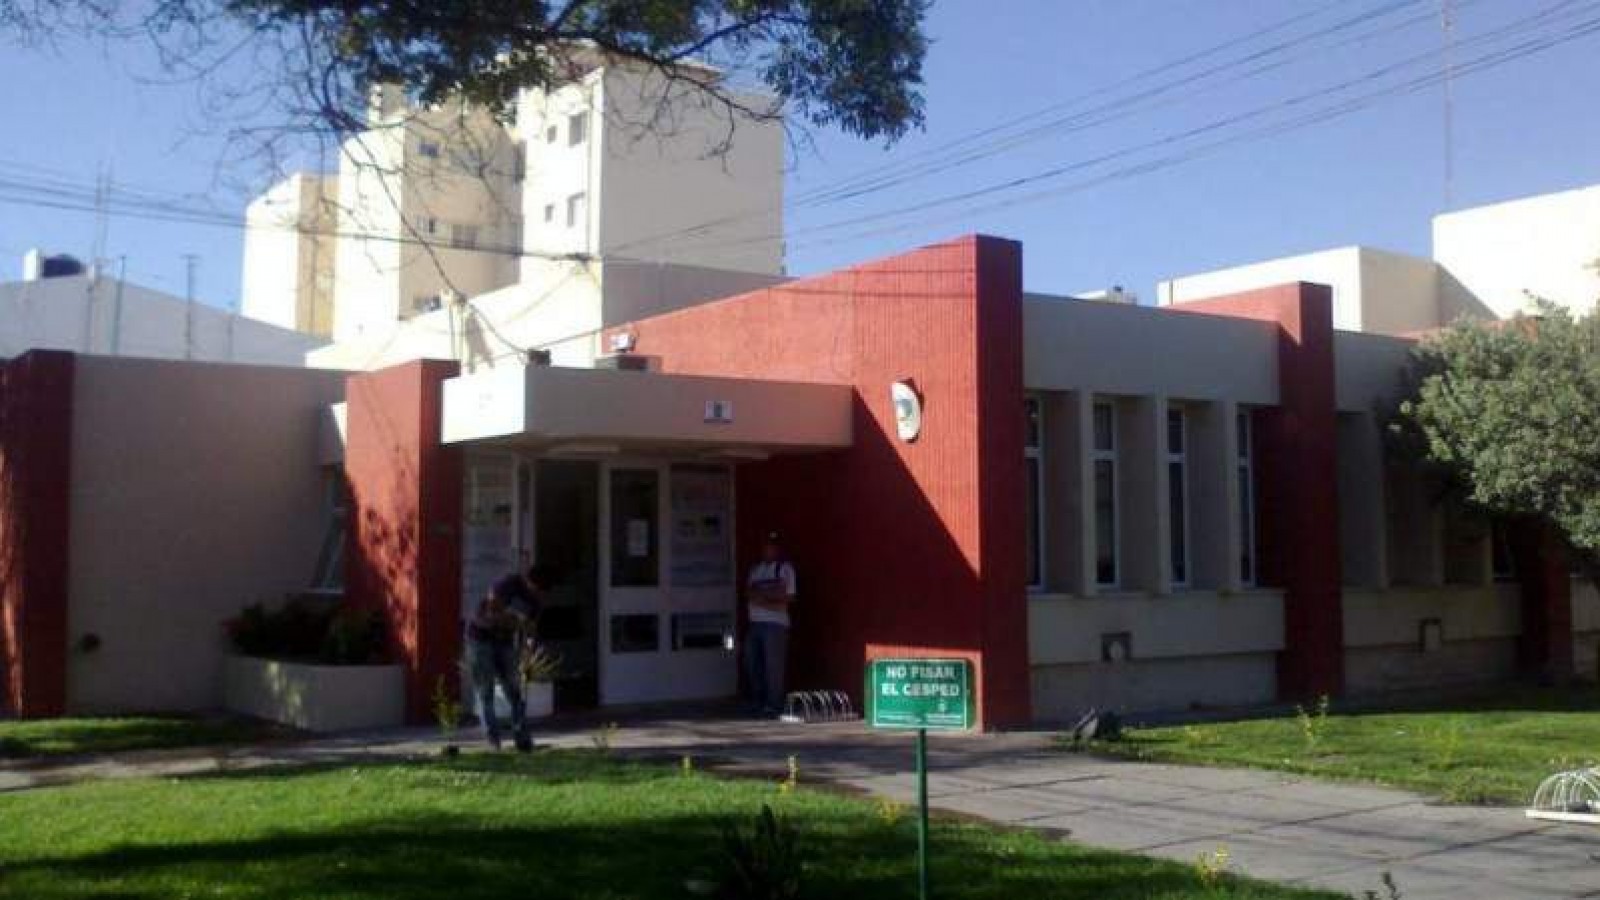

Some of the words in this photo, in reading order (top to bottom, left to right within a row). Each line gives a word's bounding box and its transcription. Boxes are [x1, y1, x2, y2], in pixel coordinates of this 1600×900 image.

[886, 666, 907, 678] NO
[911, 666, 957, 679] PISAR
[880, 683, 899, 696] EL
[902, 683, 960, 696] CESPED
